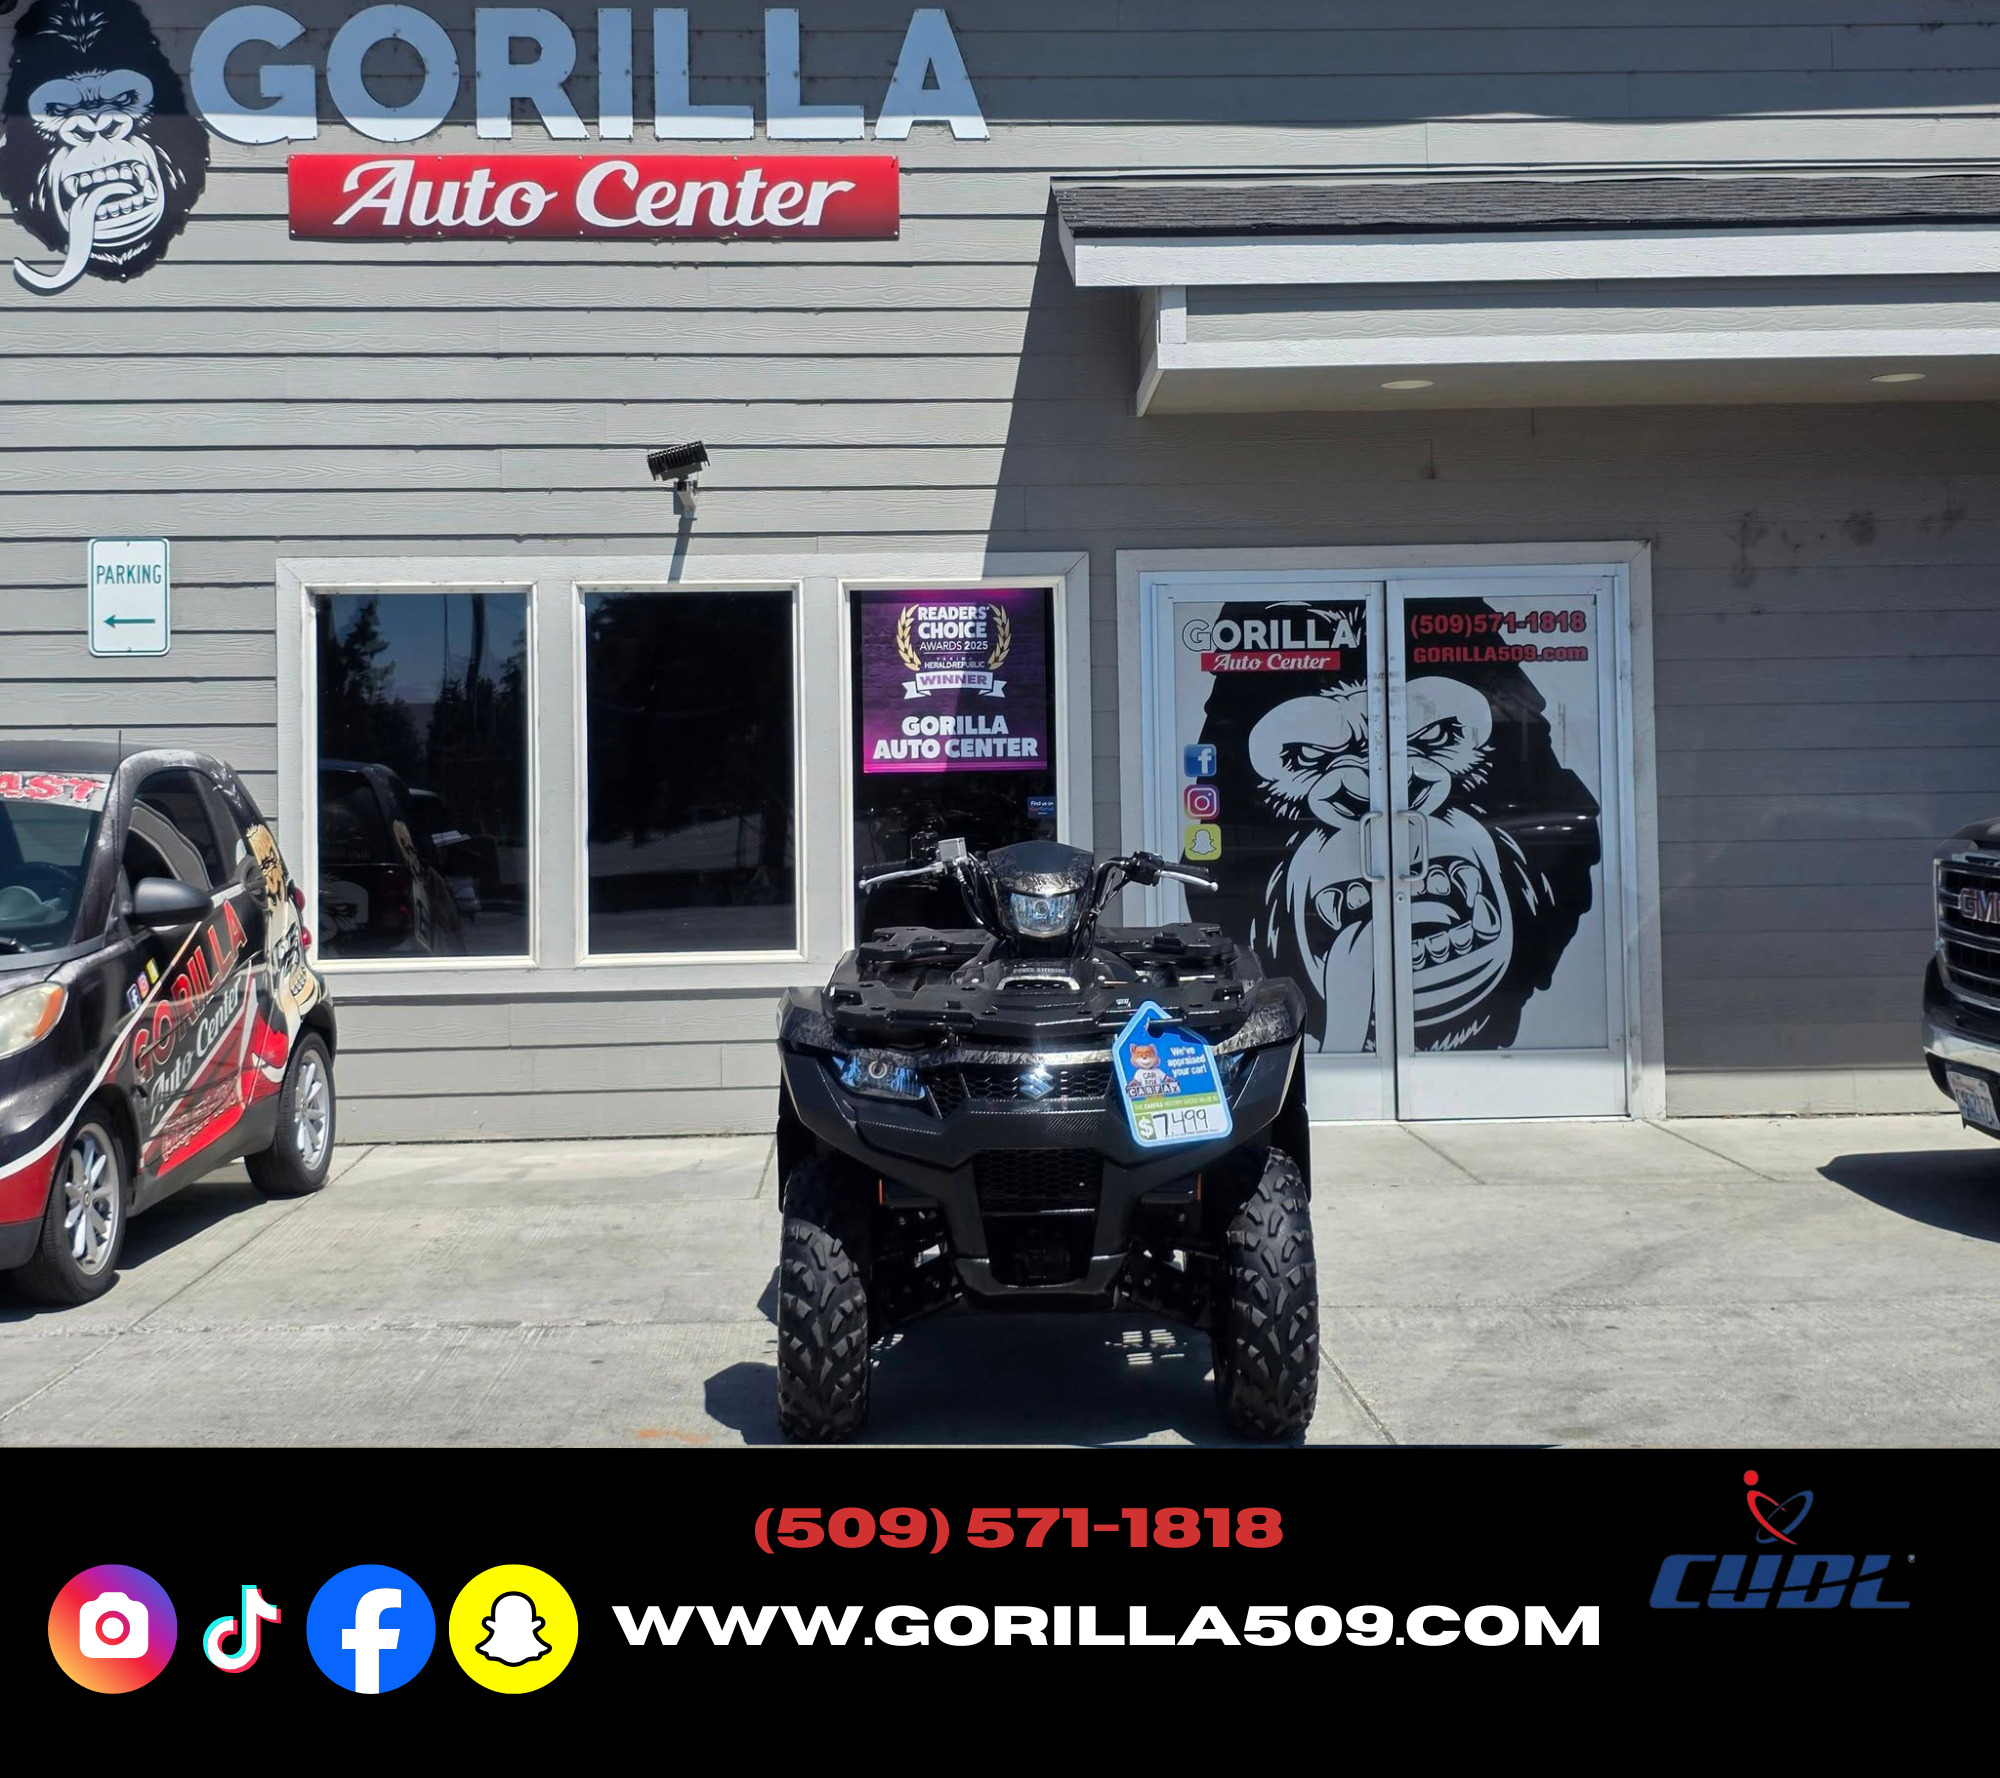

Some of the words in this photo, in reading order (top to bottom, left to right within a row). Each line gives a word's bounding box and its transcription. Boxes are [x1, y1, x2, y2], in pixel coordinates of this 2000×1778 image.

[190, 4, 991, 144] GORILLA
[332, 159, 556, 228] Auto
[576, 158, 856, 229] Center
[96, 564, 162, 585] PARKING
[917, 606, 990, 621] READERS'
[917, 621, 988, 639] CHOICE
[1410, 610, 1587, 639] (509)571-1818
[1182, 618, 1358, 652] GORILLA
[920, 641, 962, 651] AWARDS
[964, 641, 989, 650] 2025
[1413, 644, 1588, 664] GORILLA509.com
[1212, 653, 1264, 671] Auto
[1266, 653, 1331, 671] Center
[920, 674, 988, 686] WINNER
[901, 715, 1009, 737] GORILLA
[873, 738, 941, 759] AUTO
[944, 737, 1039, 758] CENTER
[133, 898, 248, 1087] GORILLA
[150, 1050, 195, 1125] Auto
[195, 975, 242, 1058] Center
[1170, 1046, 1196, 1056] We've
[1167, 1054, 1206, 1068] appraised
[1142, 1072, 1157, 1080] CAR
[1172, 1067, 1190, 1078] your
[1129, 1083, 1180, 1097] CARFAX
